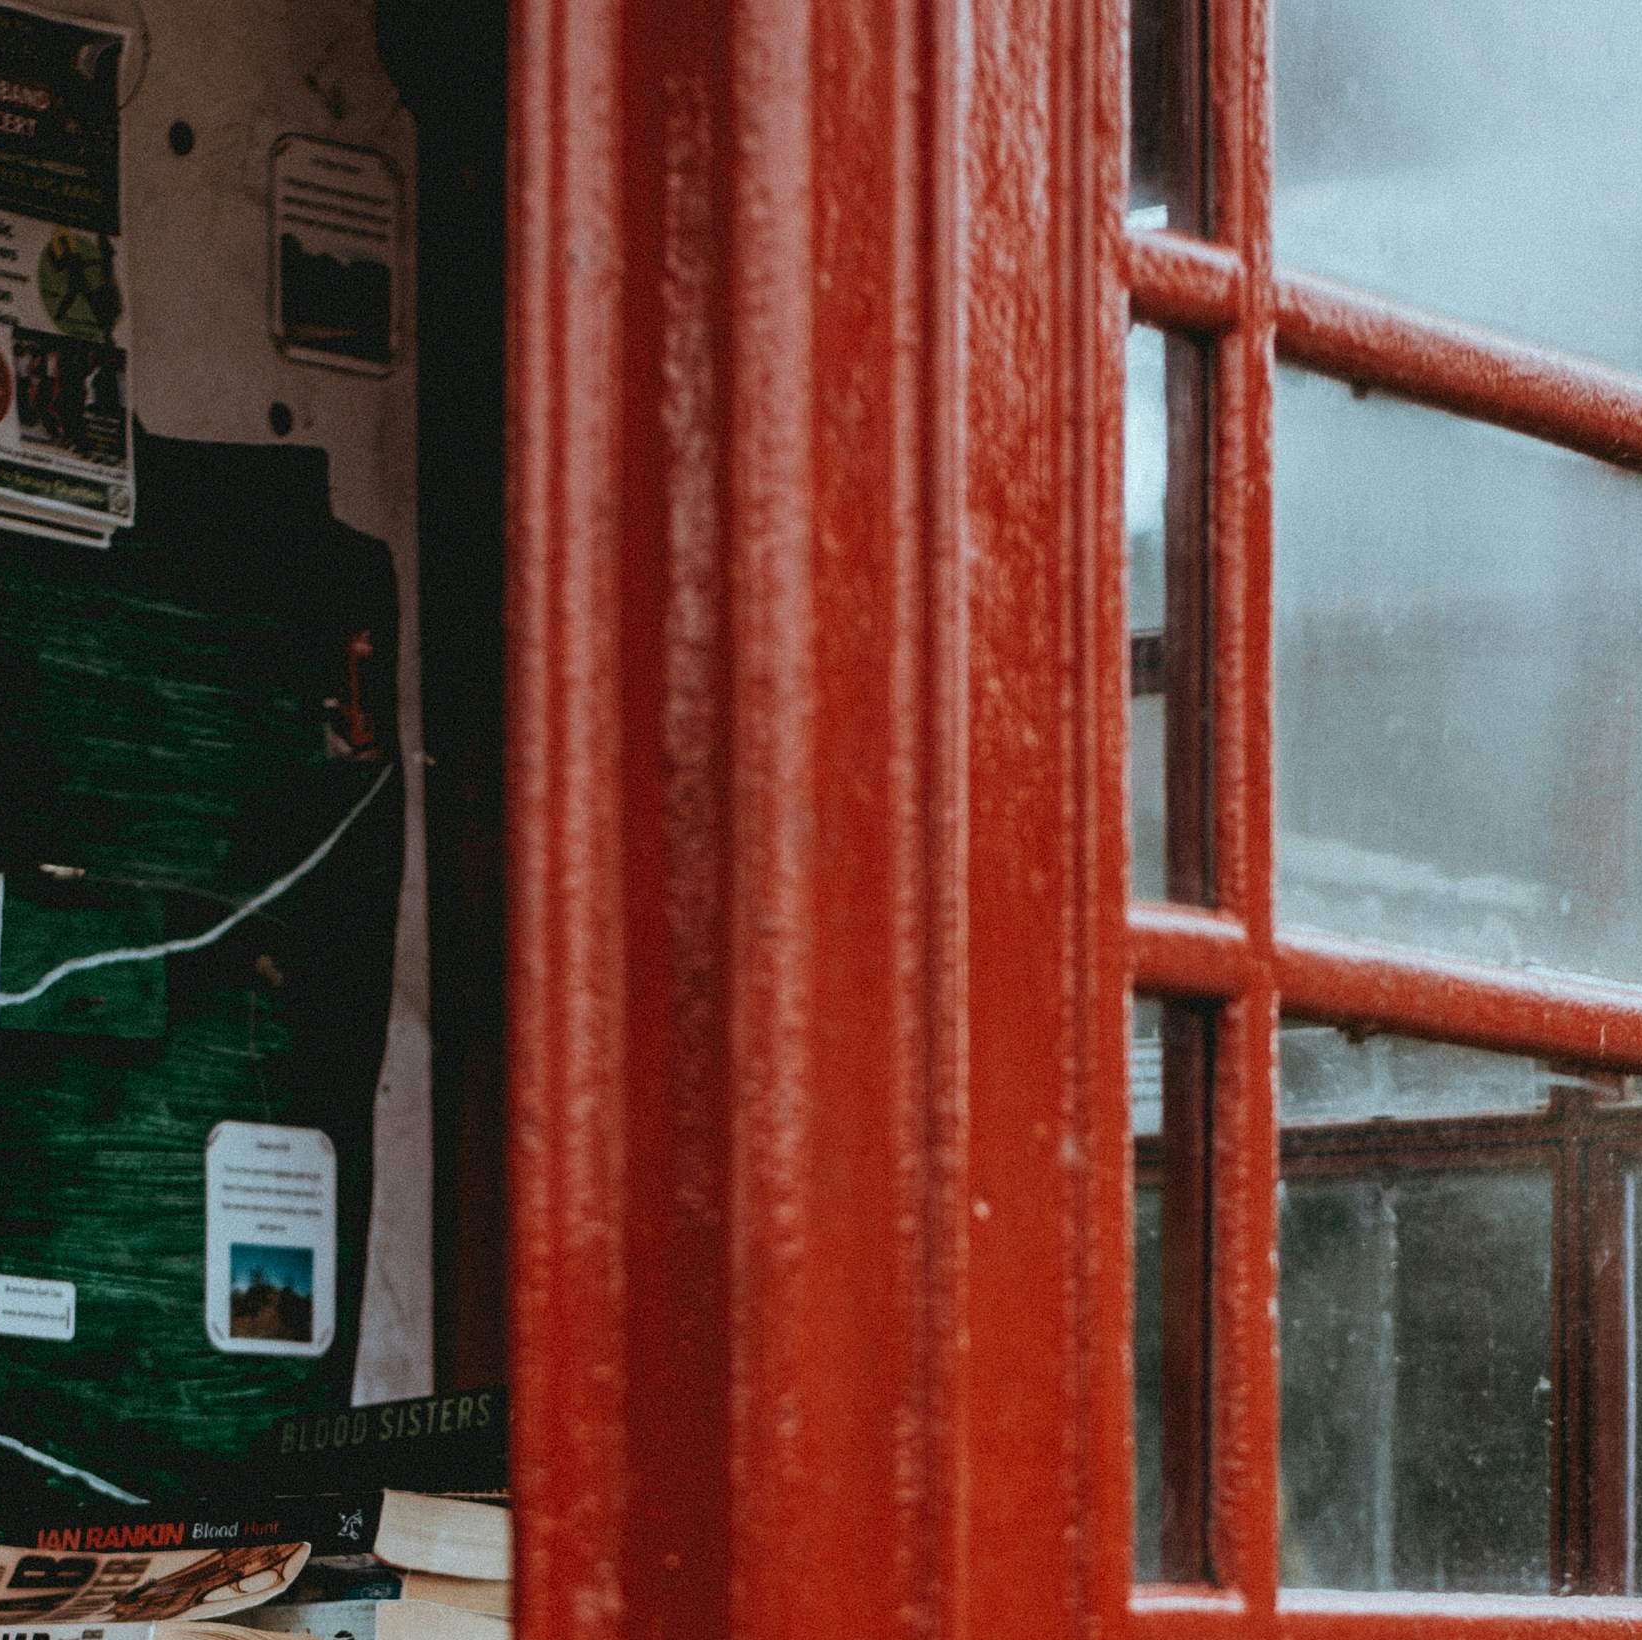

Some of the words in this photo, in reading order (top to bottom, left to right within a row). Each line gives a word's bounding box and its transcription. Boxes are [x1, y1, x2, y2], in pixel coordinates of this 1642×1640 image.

[280, 1412, 365, 1454] BLOOD
[378, 1393, 493, 1441] SISTERS
[37, 1528, 81, 1551] IAN
[85, 1523, 185, 1549] RANKIN
[192, 1522, 238, 1539] Blood
